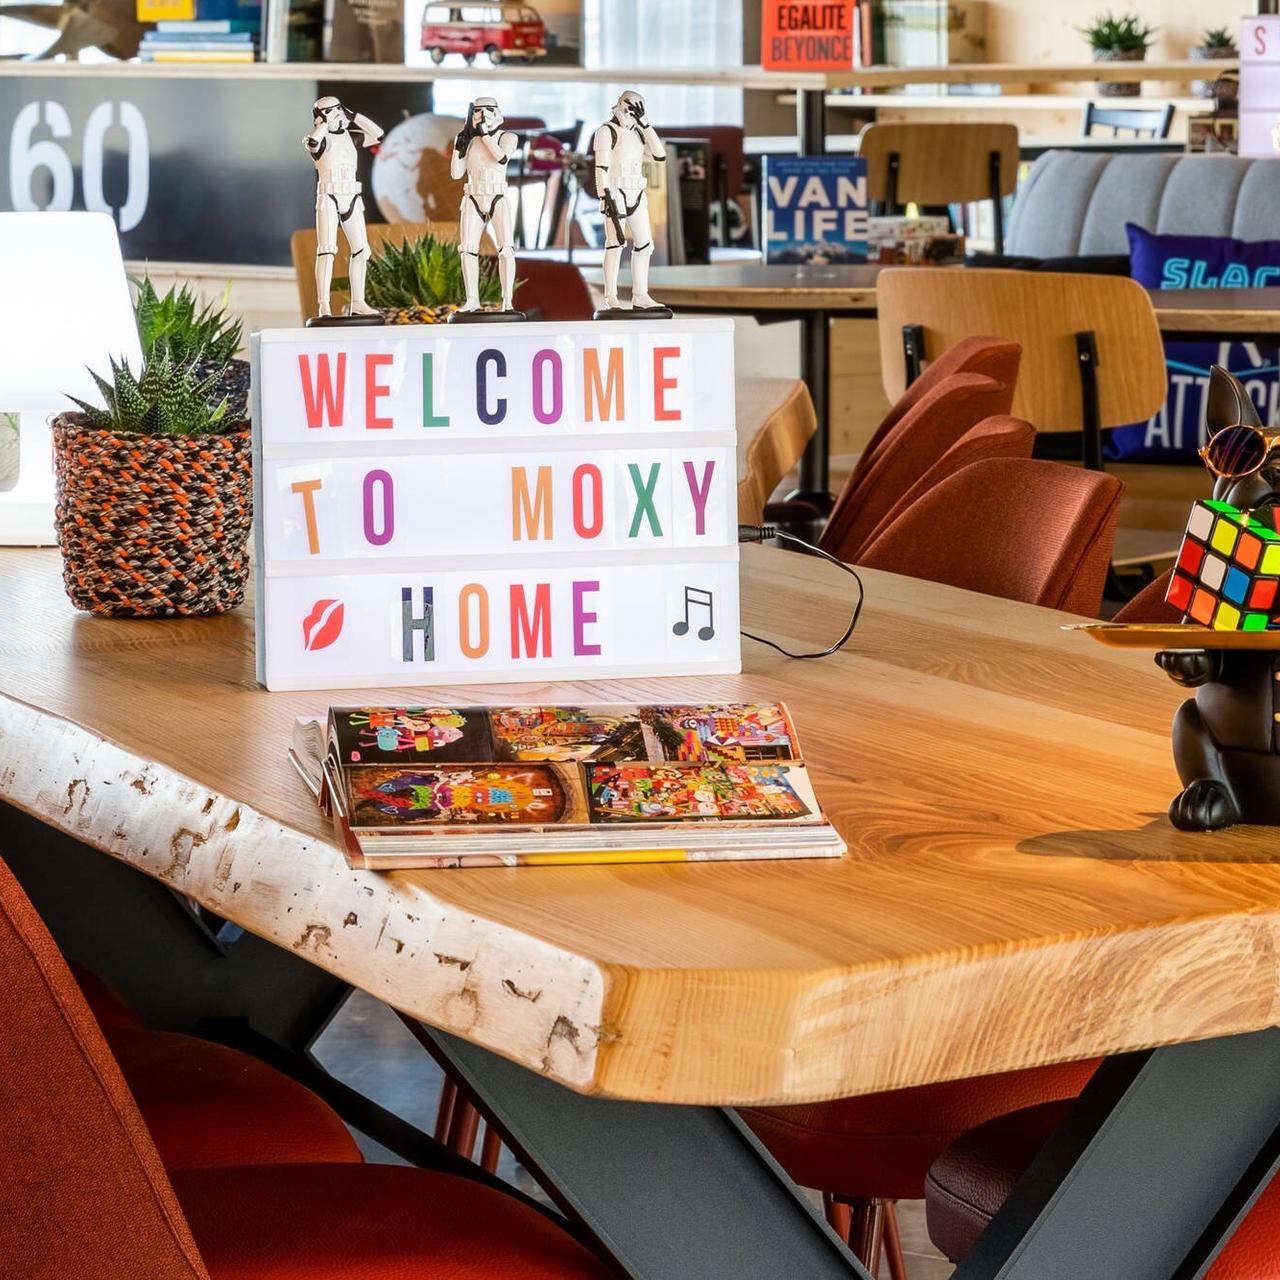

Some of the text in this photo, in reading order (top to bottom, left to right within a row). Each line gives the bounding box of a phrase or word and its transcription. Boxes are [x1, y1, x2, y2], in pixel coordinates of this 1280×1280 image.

[10, 101, 149, 231] 60
[769, 176, 867, 208] VAN
[767, 210, 869, 241] LIFE
[298, 346, 682, 429] WELCOME
[291, 461, 716, 555] TO MOXY
[402, 580, 602, 662] HOME
